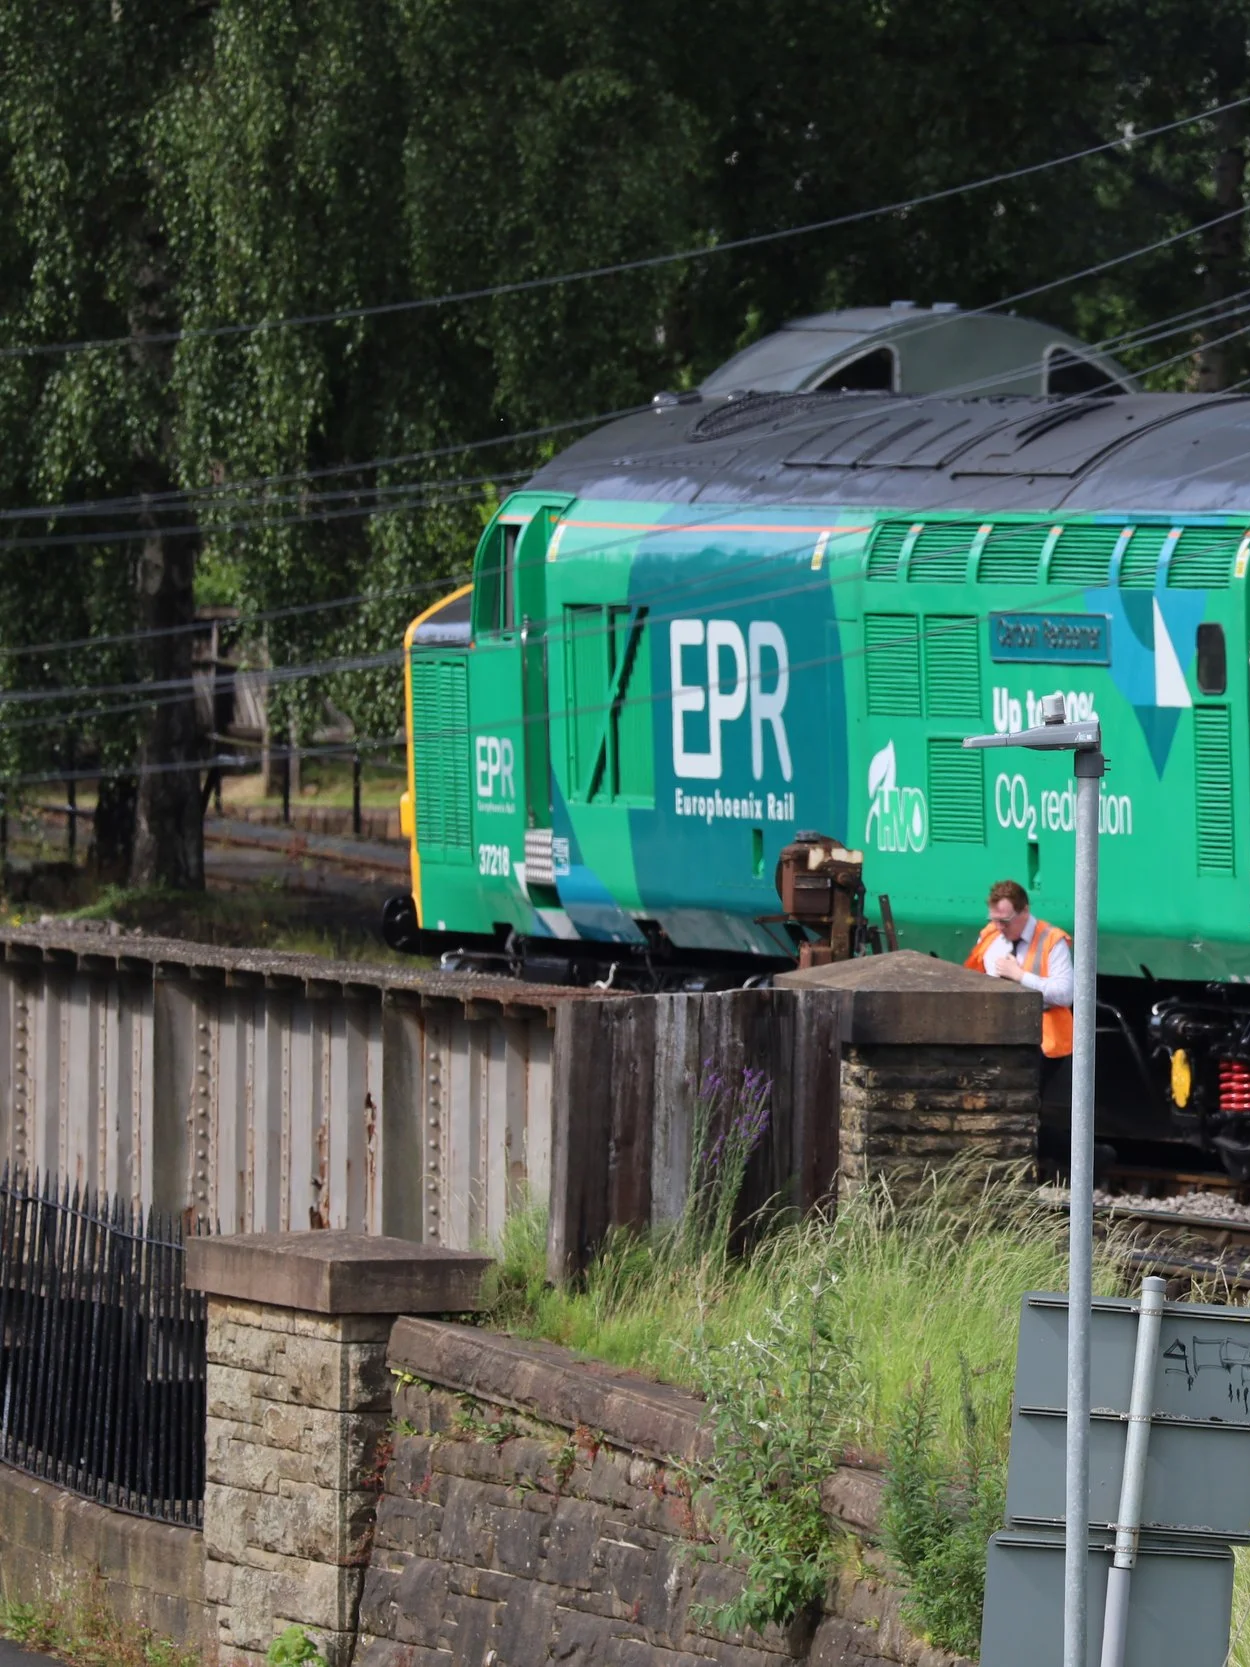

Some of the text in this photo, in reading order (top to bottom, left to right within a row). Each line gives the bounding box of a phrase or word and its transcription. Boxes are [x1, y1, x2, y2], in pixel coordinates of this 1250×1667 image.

[670, 619, 793, 783] EPR
[475, 735, 515, 799] EPR
[675, 787, 795, 825] Europhoenix Rail
[478, 843, 510, 876] 37218
